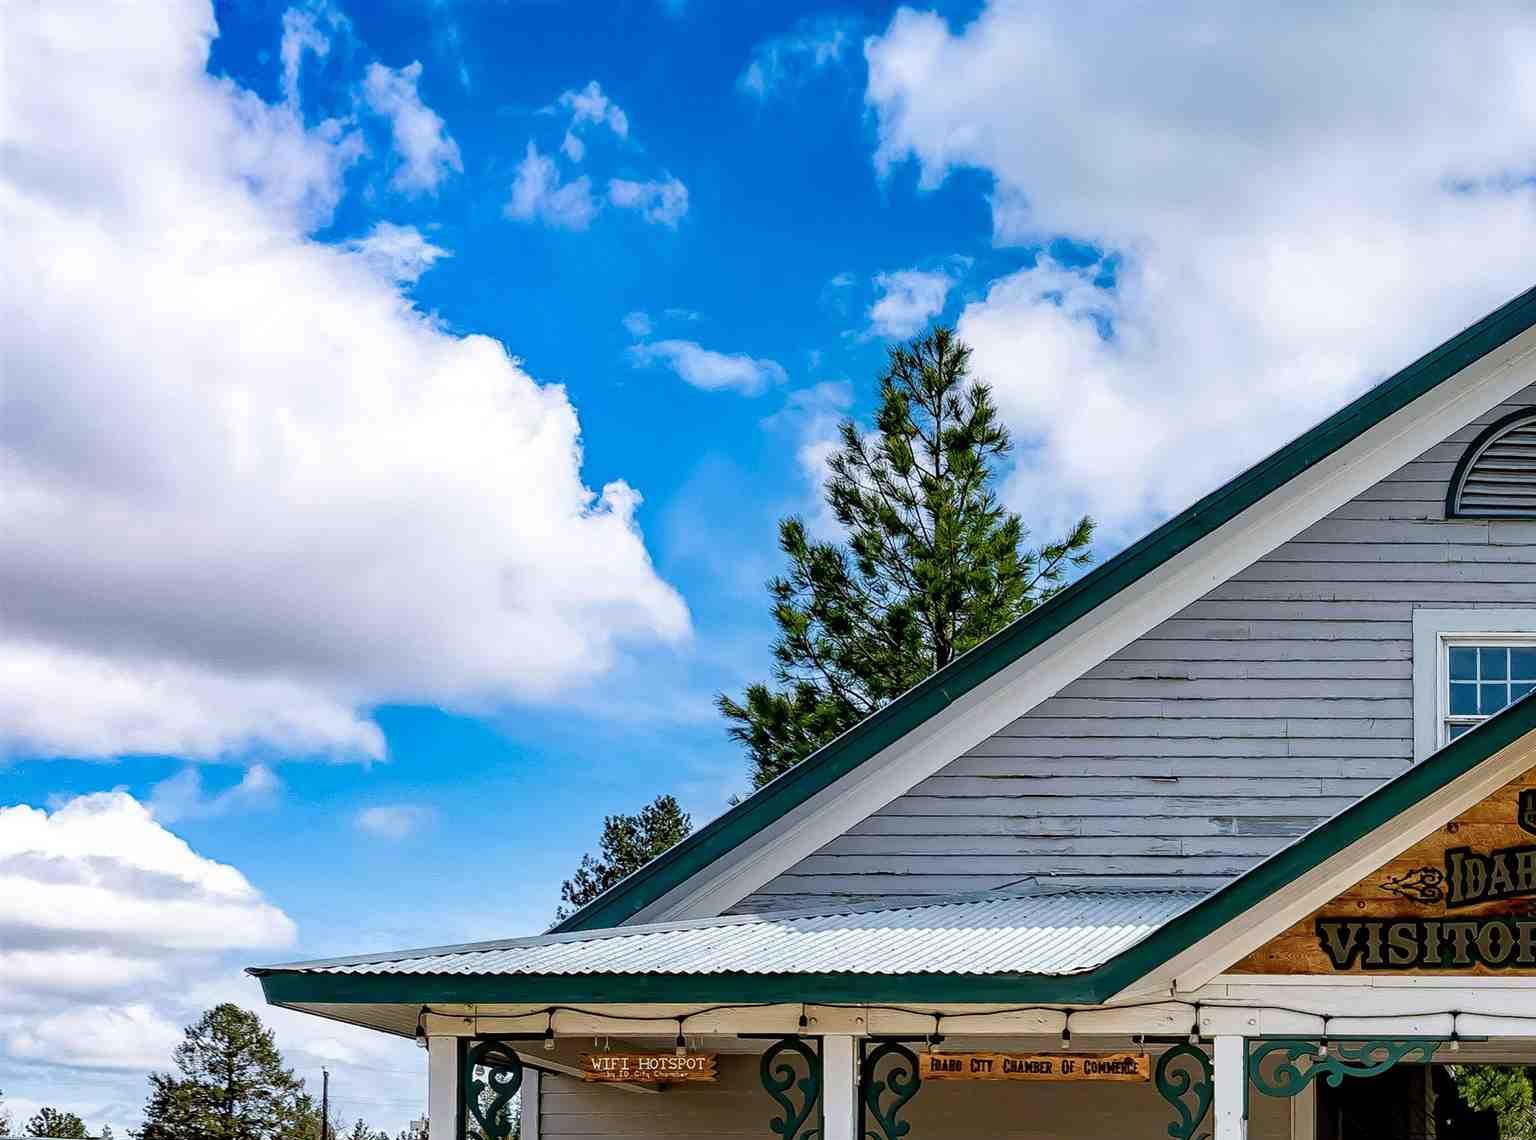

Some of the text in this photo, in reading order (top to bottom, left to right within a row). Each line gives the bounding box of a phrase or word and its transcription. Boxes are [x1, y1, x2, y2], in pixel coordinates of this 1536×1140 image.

[591, 1057, 706, 1070] WIFI HOTSPOT
[930, 1057, 1139, 1074] IDAHO CITY CHAMBER OF COMMERCE
